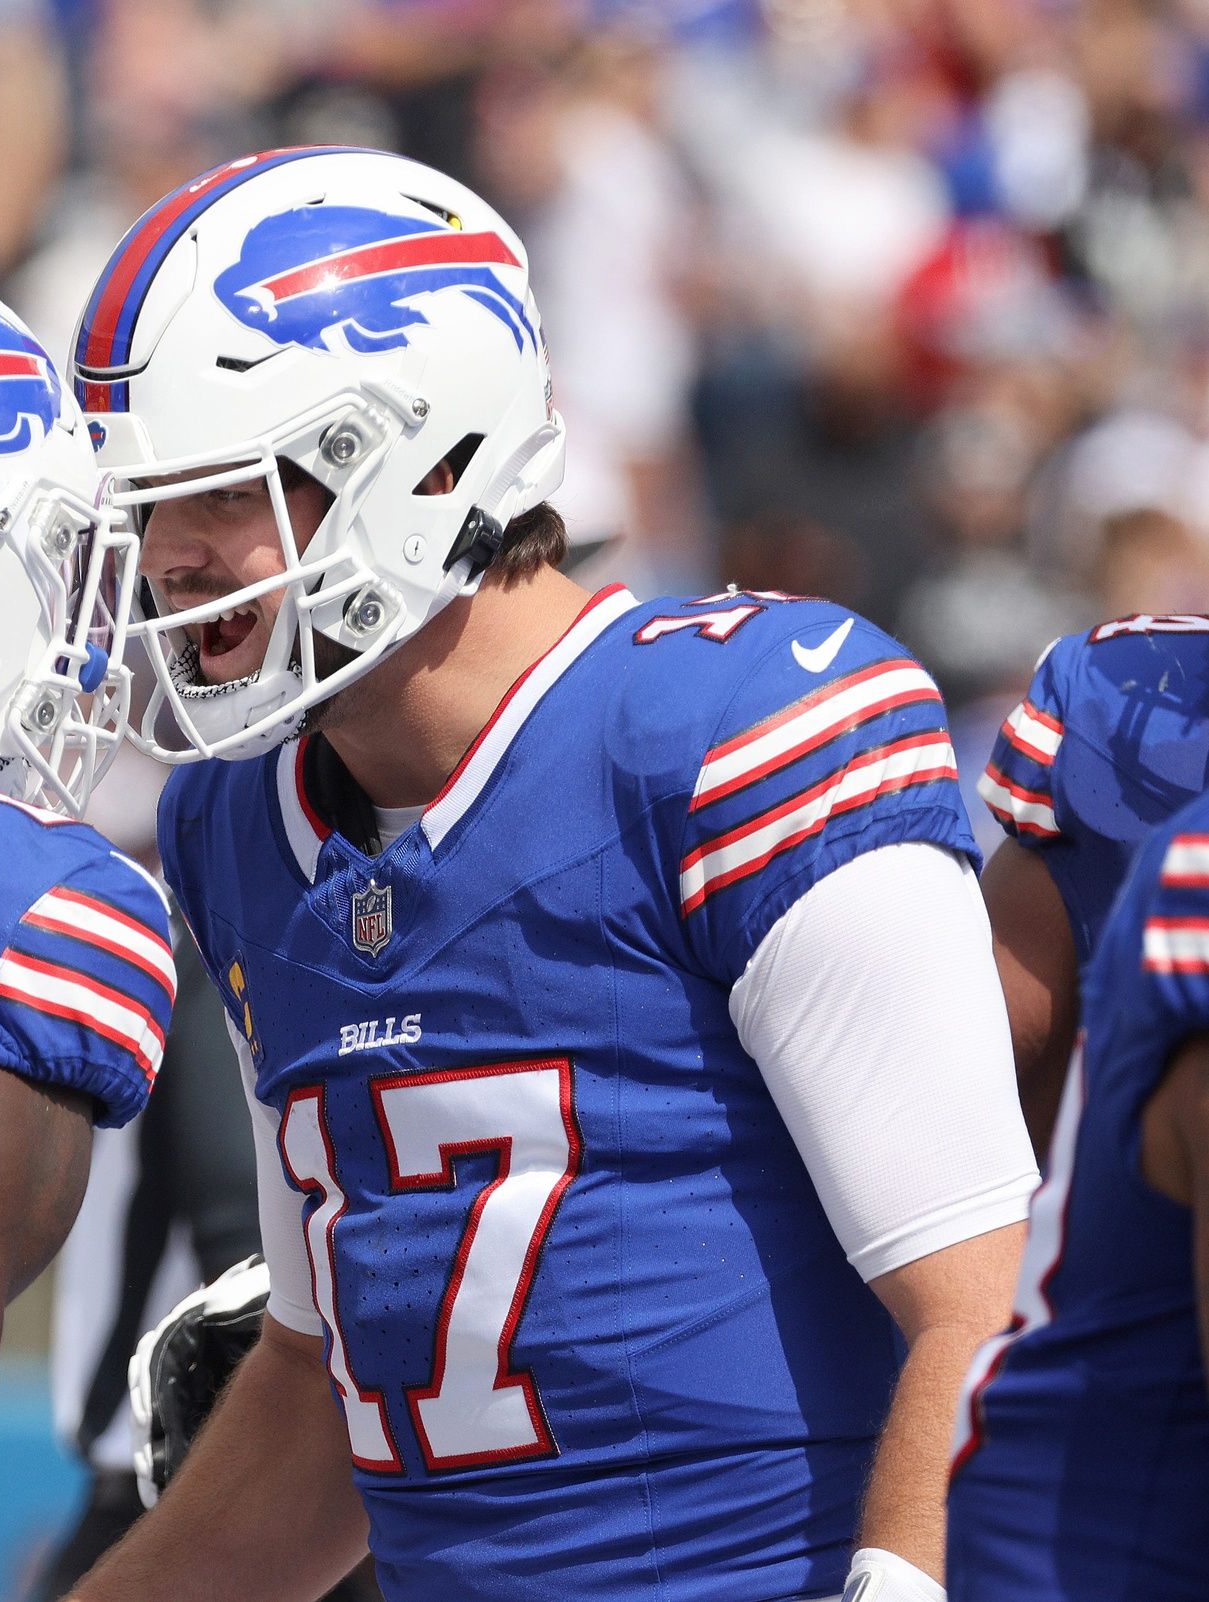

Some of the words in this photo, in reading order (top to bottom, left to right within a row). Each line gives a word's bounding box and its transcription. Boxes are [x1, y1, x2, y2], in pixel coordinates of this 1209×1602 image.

[358, 914, 385, 943] NFL
[338, 1013, 422, 1056] BILLS
[277, 1055, 585, 1477] 17
